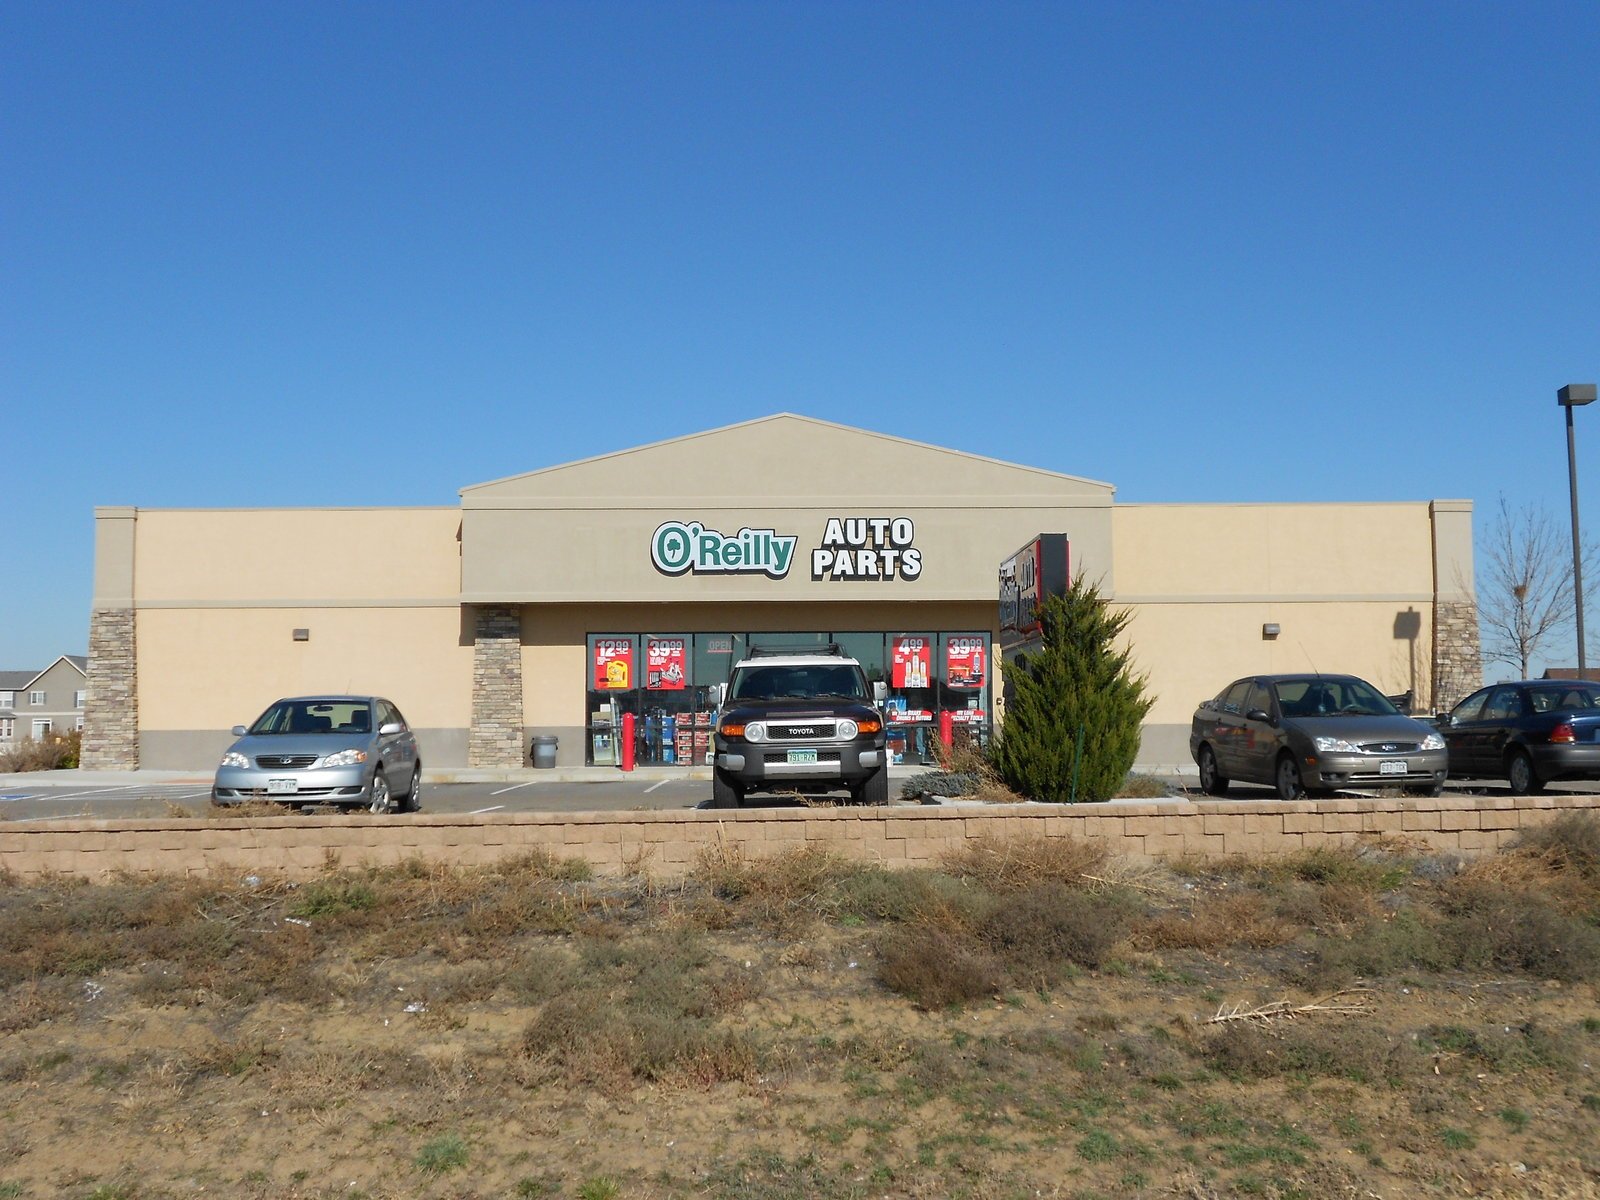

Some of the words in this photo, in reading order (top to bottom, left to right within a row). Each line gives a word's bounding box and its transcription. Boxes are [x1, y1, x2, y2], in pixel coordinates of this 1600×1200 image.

[823, 518, 914, 548] AUTO
[654, 523, 796, 575] O'Reilly
[811, 548, 922, 581] PARTS
[709, 640, 732, 650] OPEN
